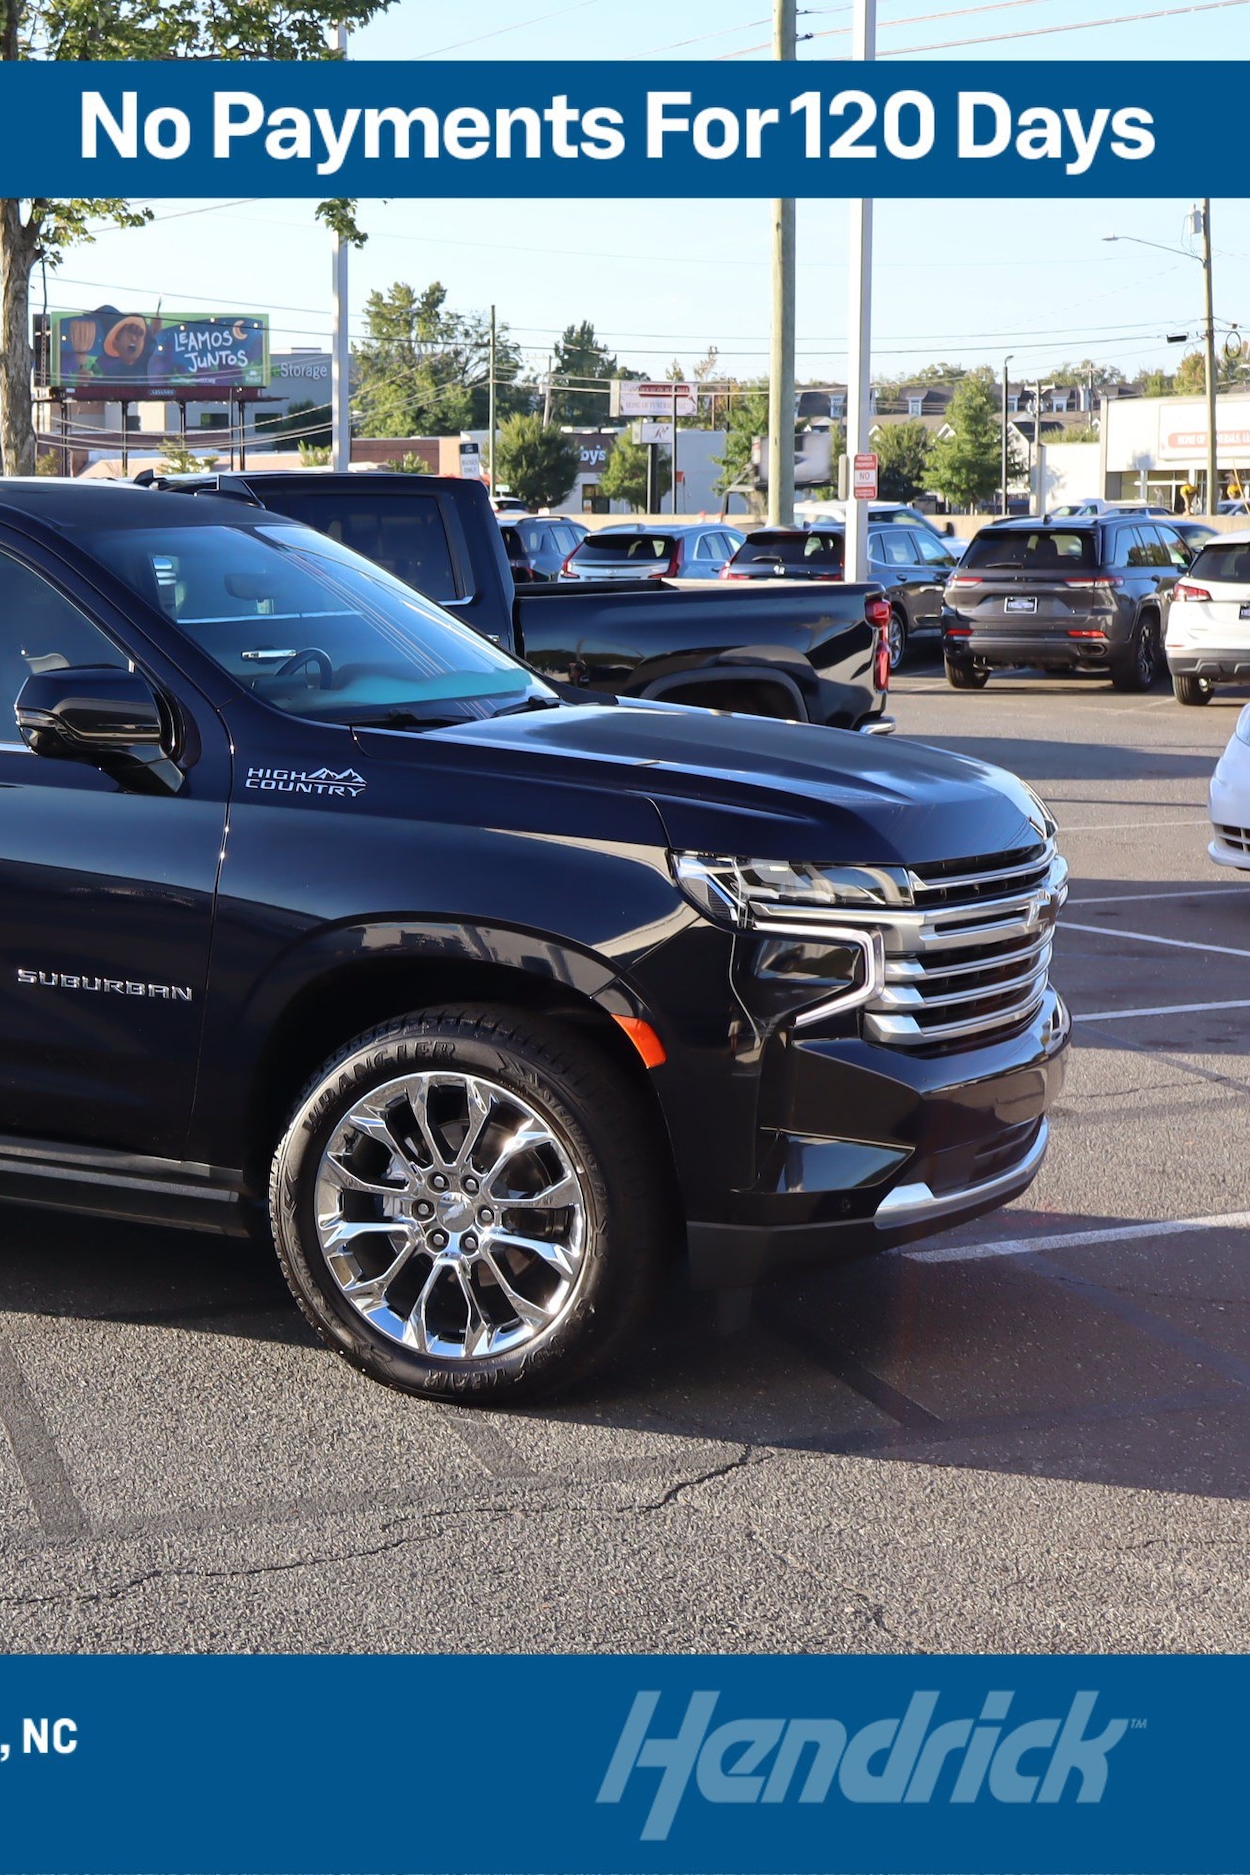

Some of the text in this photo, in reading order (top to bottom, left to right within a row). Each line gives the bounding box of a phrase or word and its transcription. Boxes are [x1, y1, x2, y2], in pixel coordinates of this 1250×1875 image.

[174, 330, 234, 352] LEAMOS
[184, 350, 249, 373] JUNTOS
[859, 472, 870, 480] NO
[248, 767, 306, 781] HIGH
[245, 779, 366, 797] COUNTRY
[17, 968, 193, 1001] SUBURBAN
[301, 1040, 456, 1135] WRANGLER
